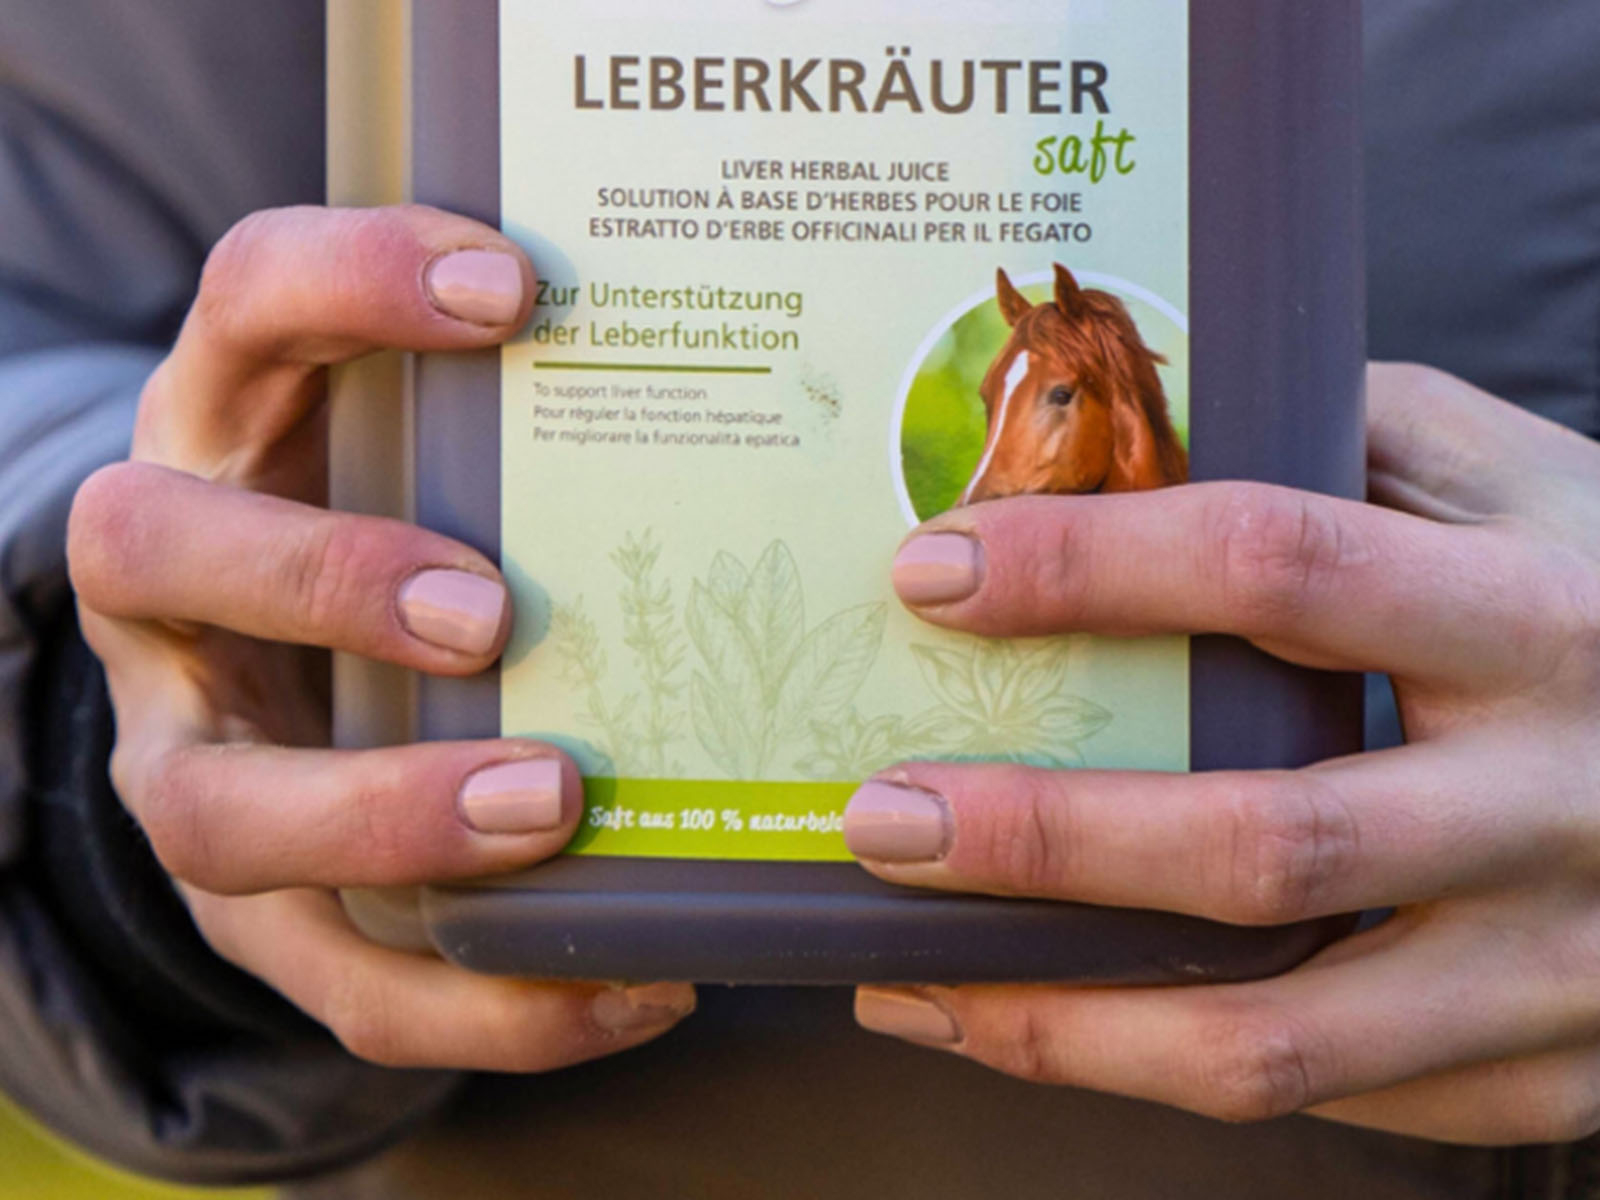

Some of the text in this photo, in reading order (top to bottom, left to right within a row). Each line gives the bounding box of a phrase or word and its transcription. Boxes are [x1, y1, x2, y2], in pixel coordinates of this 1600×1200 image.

[575, 46, 1111, 115] LEBERKRÄUTER
[1033, 120, 1136, 184] saft
[721, 159, 950, 183] LIVER HERBAL JUICE
[597, 186, 1082, 213] SOLUTION À BASE D'HERBES POUR LE FOIE
[589, 217, 1093, 243] ESTRATTO D'ERBE OFFICINALI PER IL FEGATO
[535, 279, 803, 317] Zur Unterstützung
[533, 319, 799, 351] der Leberfunktion
[533, 381, 708, 401] To support liver function
[533, 404, 566, 419] Pour
[623, 407, 637, 422] la
[640, 407, 702, 424] fonction
[559, 428, 633, 446] migliorare
[635, 430, 649, 444] la
[744, 434, 801, 448] epatica
[589, 805, 635, 831] Saft
[638, 811, 675, 829] aus
[679, 808, 716, 830] 100
[720, 808, 744, 832] %
